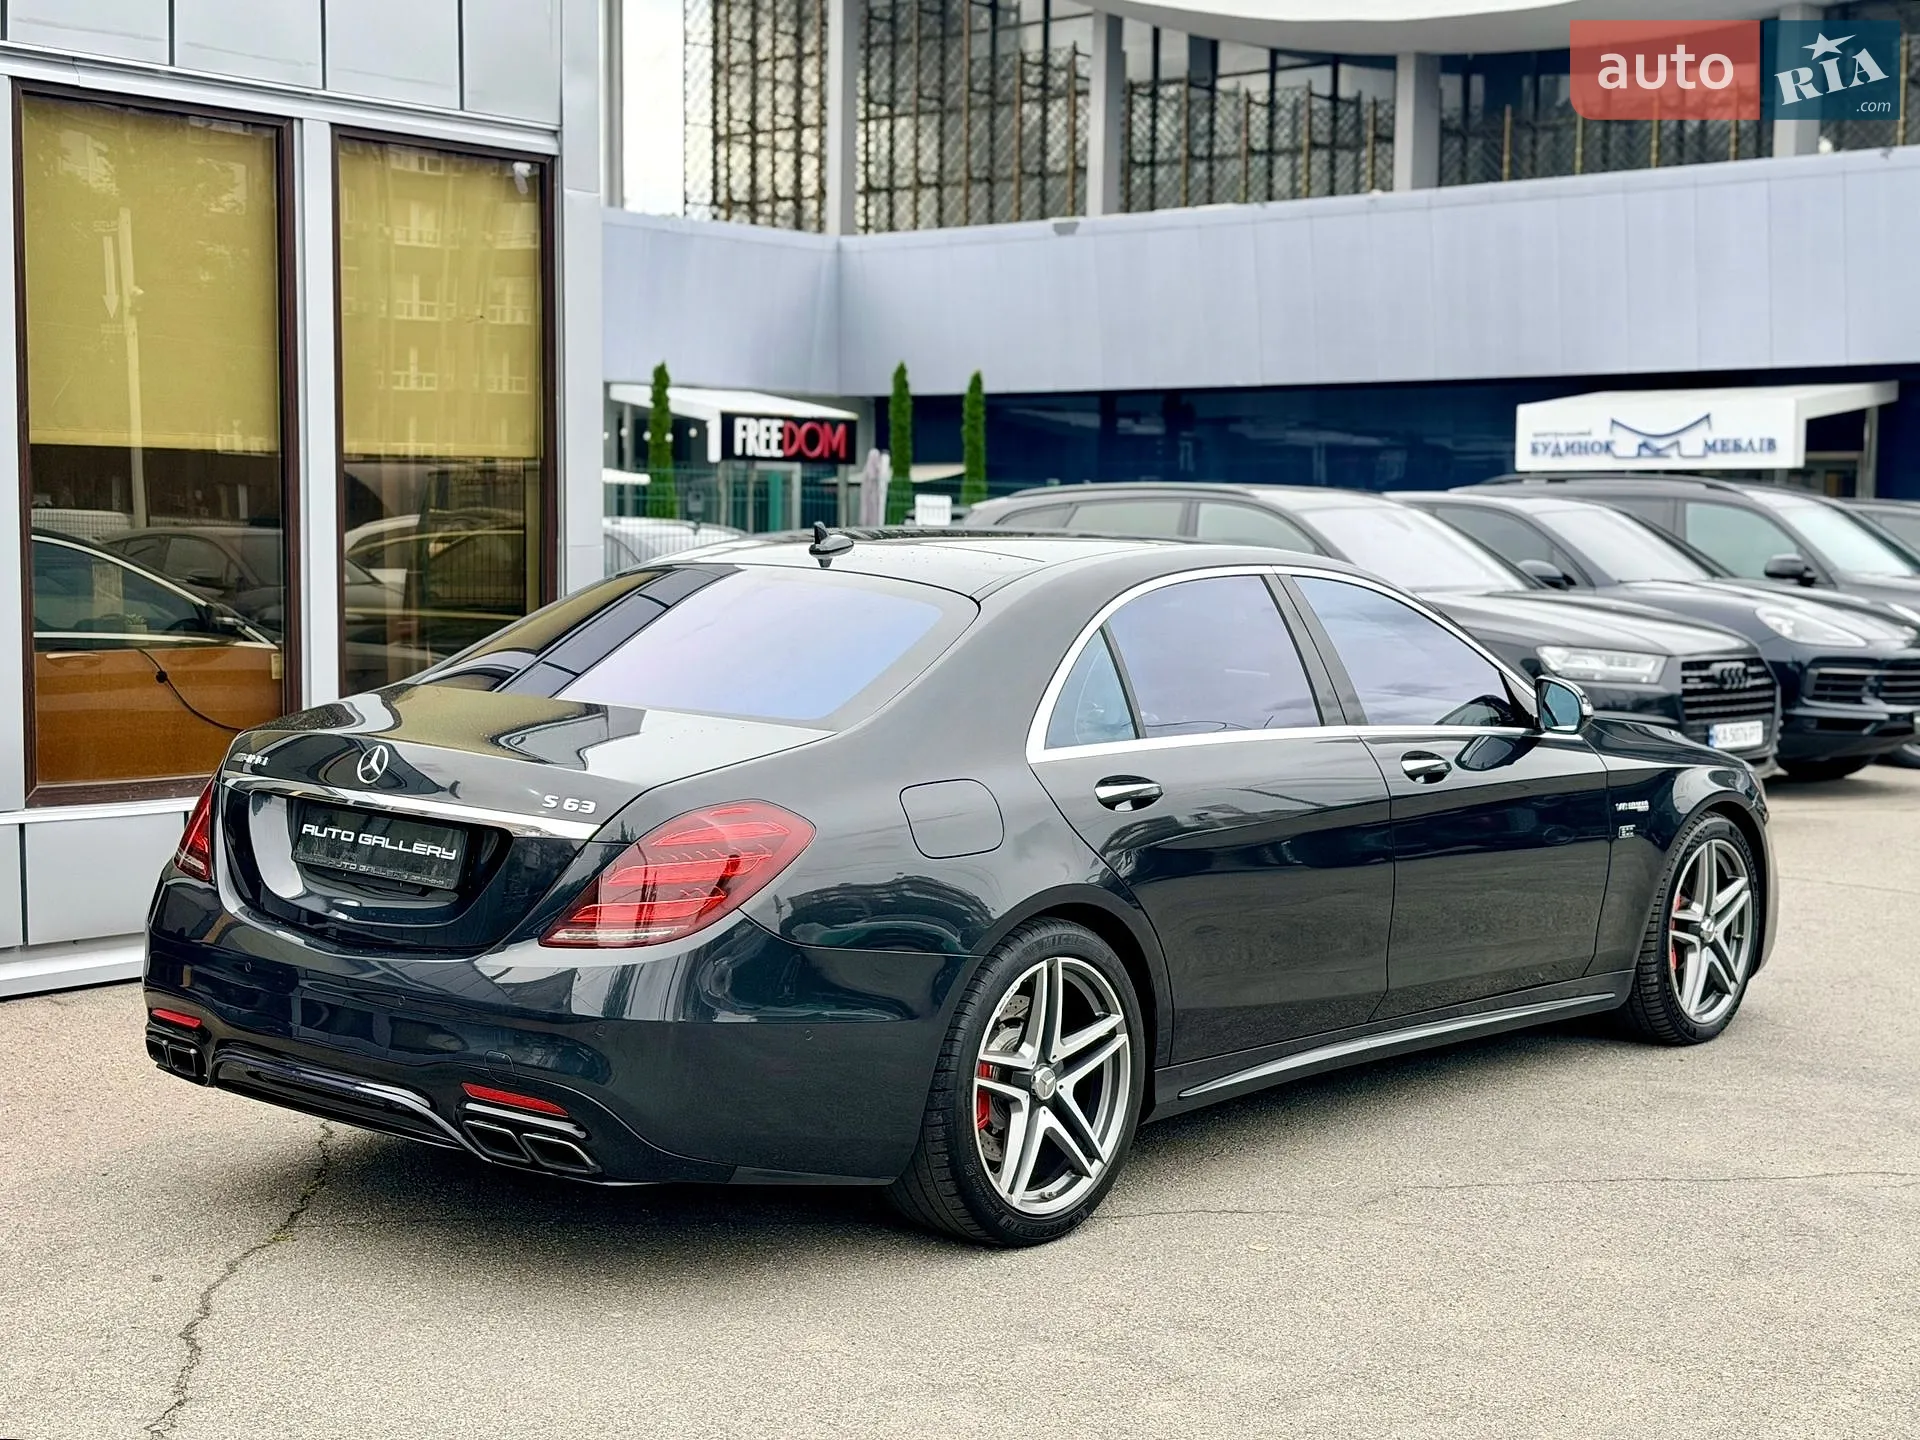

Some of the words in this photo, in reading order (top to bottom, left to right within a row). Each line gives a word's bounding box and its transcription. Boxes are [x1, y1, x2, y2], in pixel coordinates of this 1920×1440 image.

[734, 416, 847, 461] FREEDOM
[541, 794, 560, 809] S
[562, 797, 597, 815] 63
[302, 824, 355, 842] AUTO
[358, 833, 457, 861] GALLERY
